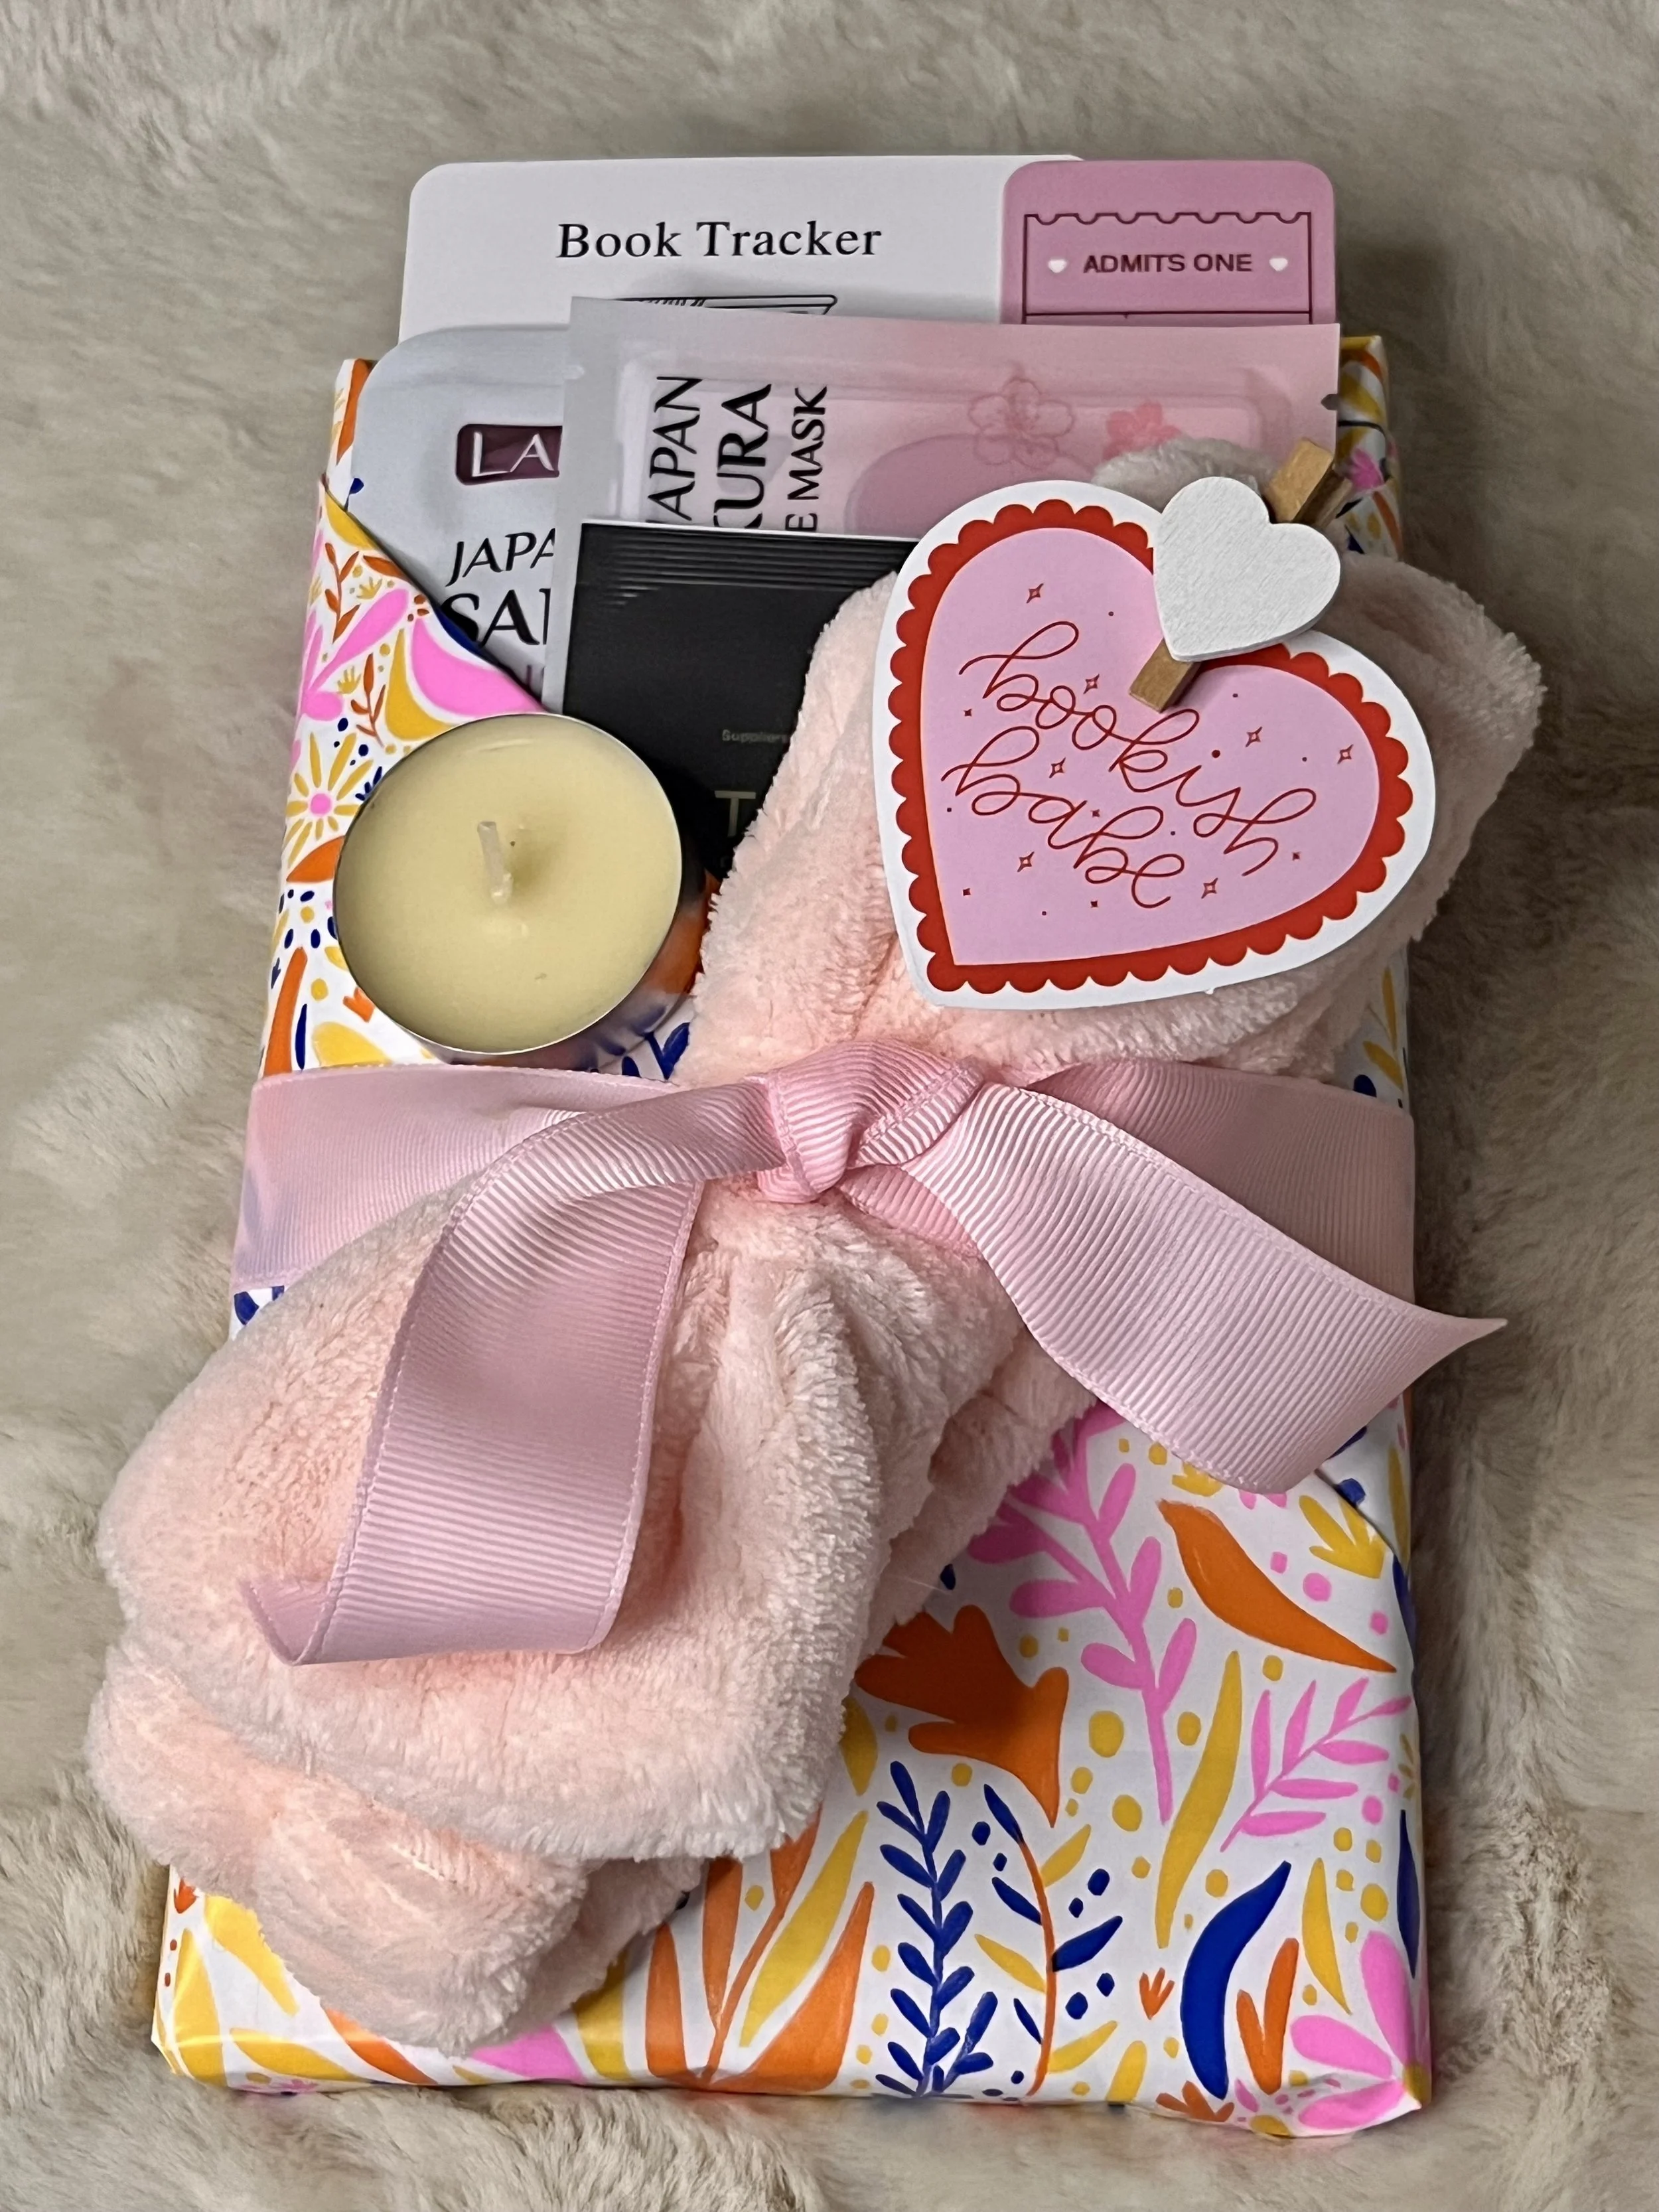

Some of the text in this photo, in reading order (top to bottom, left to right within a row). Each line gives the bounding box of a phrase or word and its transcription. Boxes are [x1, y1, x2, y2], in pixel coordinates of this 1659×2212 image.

[557, 220, 882, 258] Book Tracker
[1083, 254, 1252, 273] ADMITS ONE
[472, 431, 555, 477] LA
[645, 376, 703, 523] APAN
[787, 386, 828, 501] MASK
[959, 621, 1317, 877] bookish
[941, 726, 1185, 908] babe
